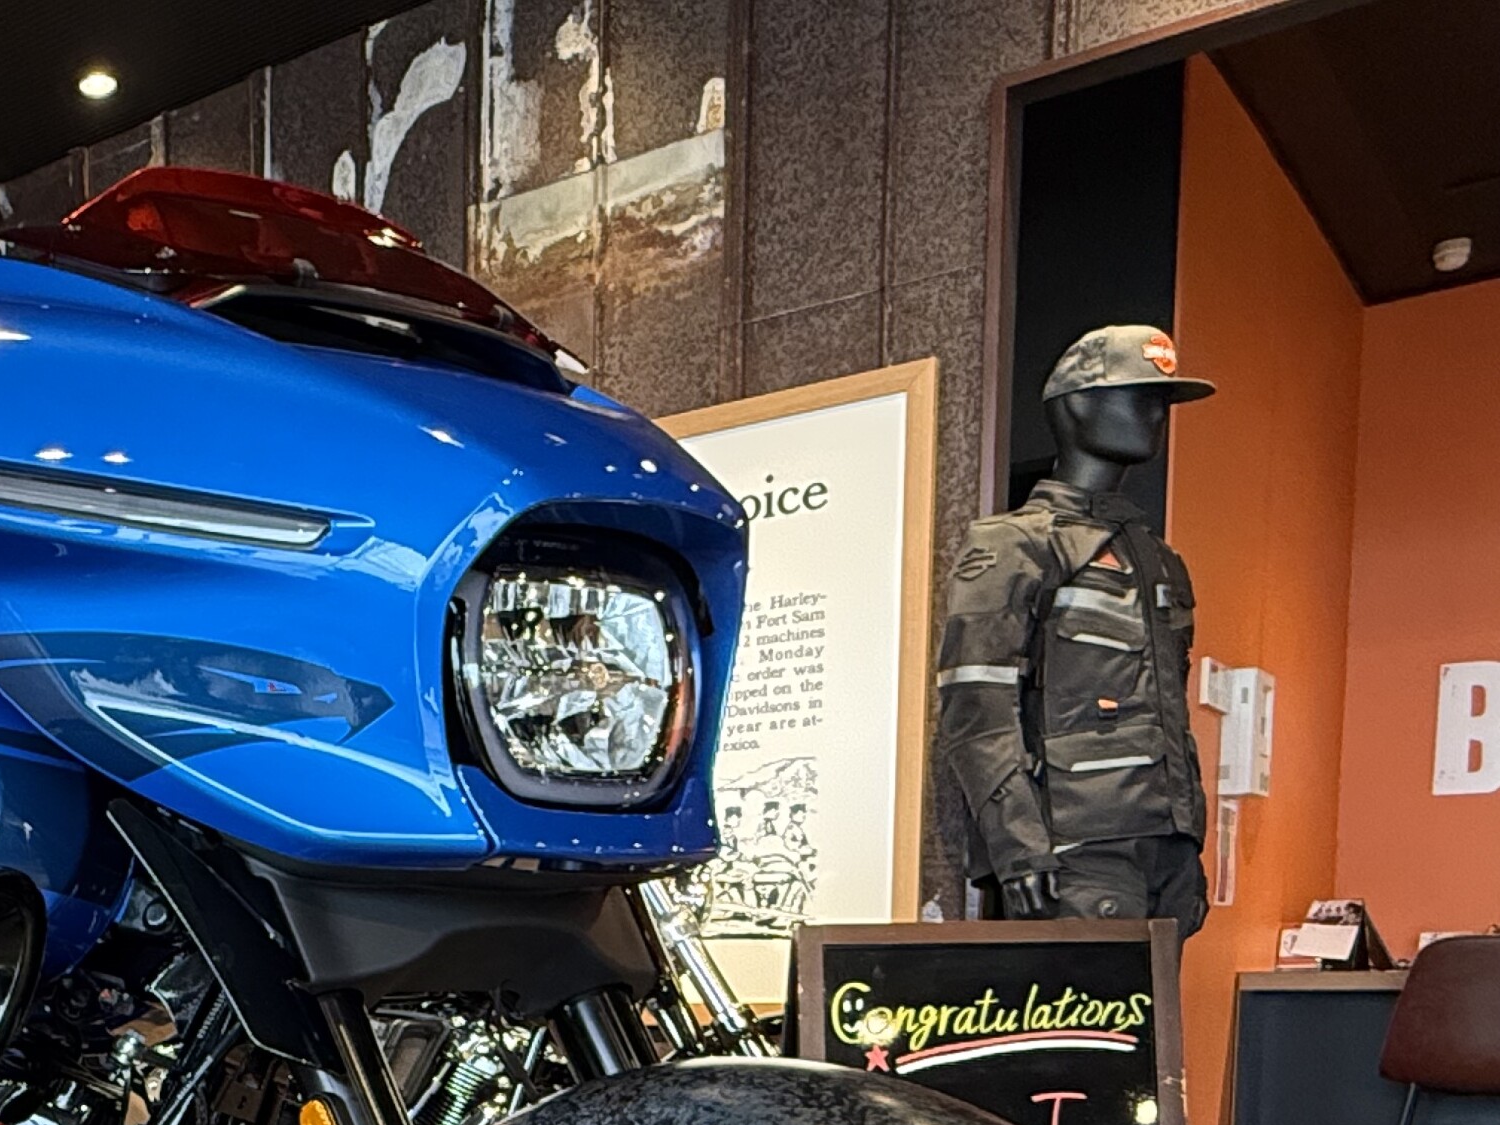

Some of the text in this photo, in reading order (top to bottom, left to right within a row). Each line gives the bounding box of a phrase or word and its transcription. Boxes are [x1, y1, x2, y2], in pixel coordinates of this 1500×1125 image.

[769, 592, 827, 610] Harley-
[756, 613, 788, 629] Fort
[792, 609, 826, 624] Sam
[756, 627, 826, 646] machines
[758, 645, 825, 664] Monday
[747, 667, 786, 682] order
[793, 662, 824, 676] was
[772, 684, 792, 696] on
[800, 678, 823, 693] the
[726, 696, 823, 719] Davidsons in
[726, 721, 762, 738] year
[769, 718, 797, 731] are
[831, 982, 1152, 1051] Congratulations
